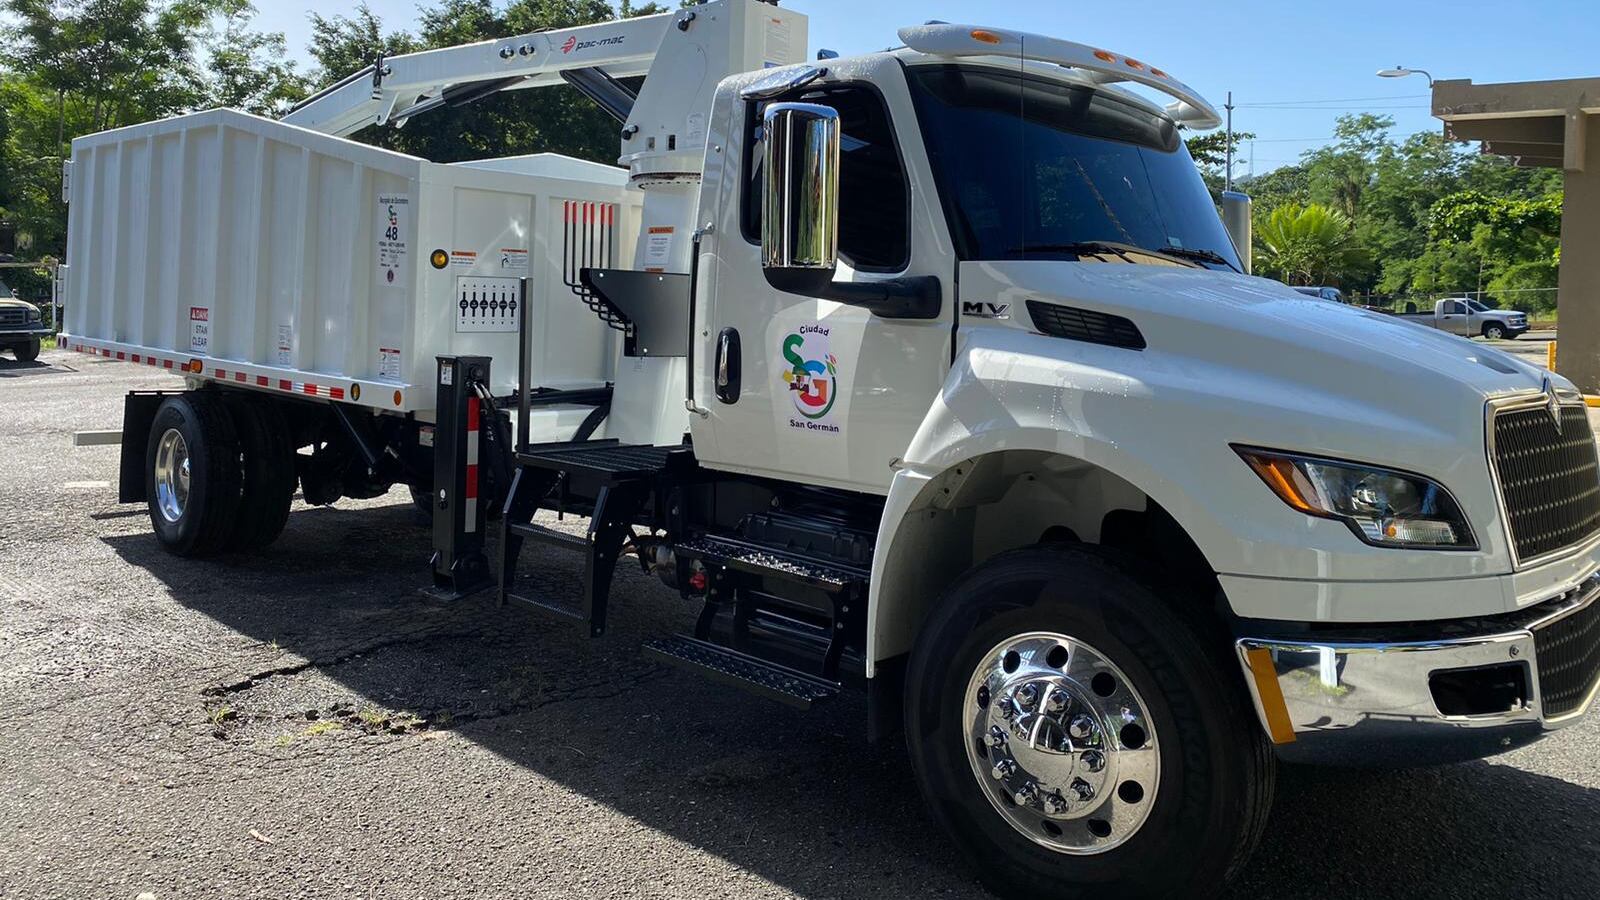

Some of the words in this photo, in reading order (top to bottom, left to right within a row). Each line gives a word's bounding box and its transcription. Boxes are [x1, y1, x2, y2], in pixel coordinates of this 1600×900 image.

[576, 36, 625, 51] pac-mac
[385, 226, 398, 241] 48
[963, 301, 1010, 316] MV
[800, 325, 829, 336] Ciudad
[790, 419, 805, 428] San
[807, 421, 839, 433] Germán
